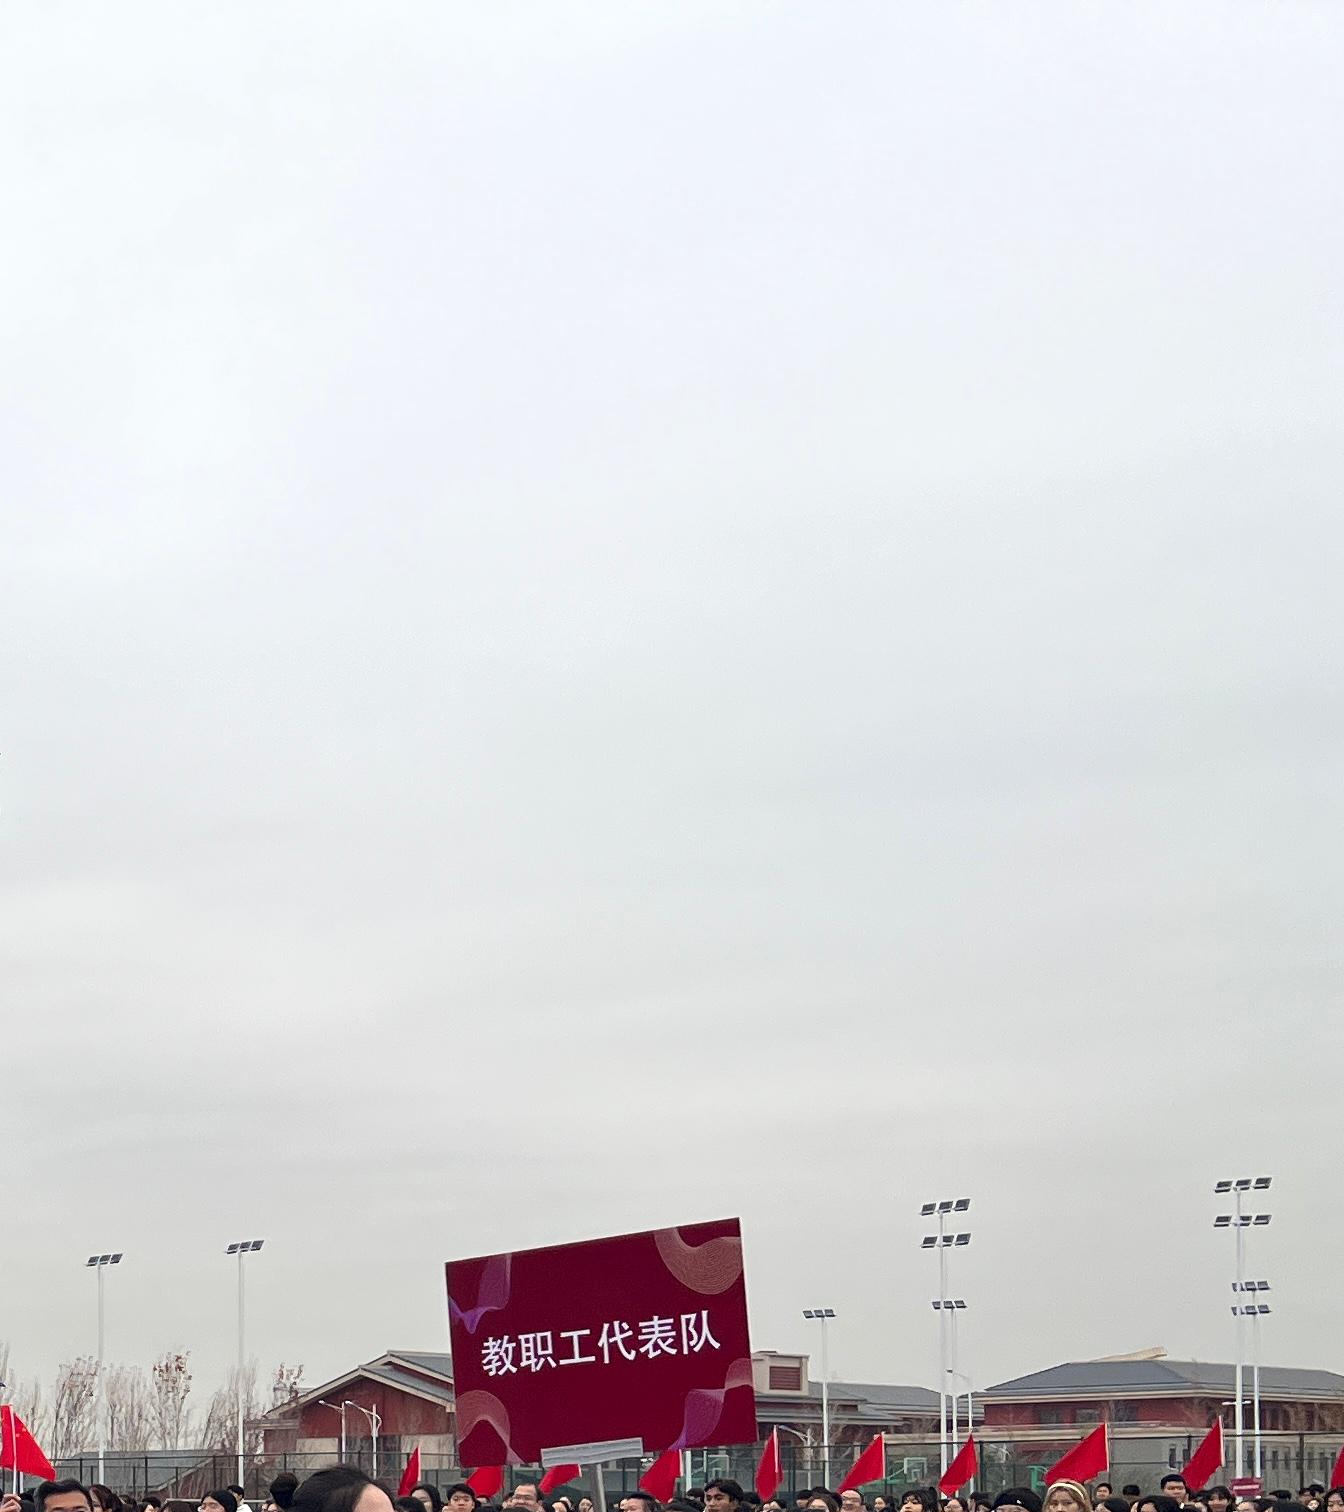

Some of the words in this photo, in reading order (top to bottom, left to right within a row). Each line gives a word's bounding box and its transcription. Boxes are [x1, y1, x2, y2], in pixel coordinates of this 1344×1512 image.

[481, 1310, 721, 1377] 教职工代表队
